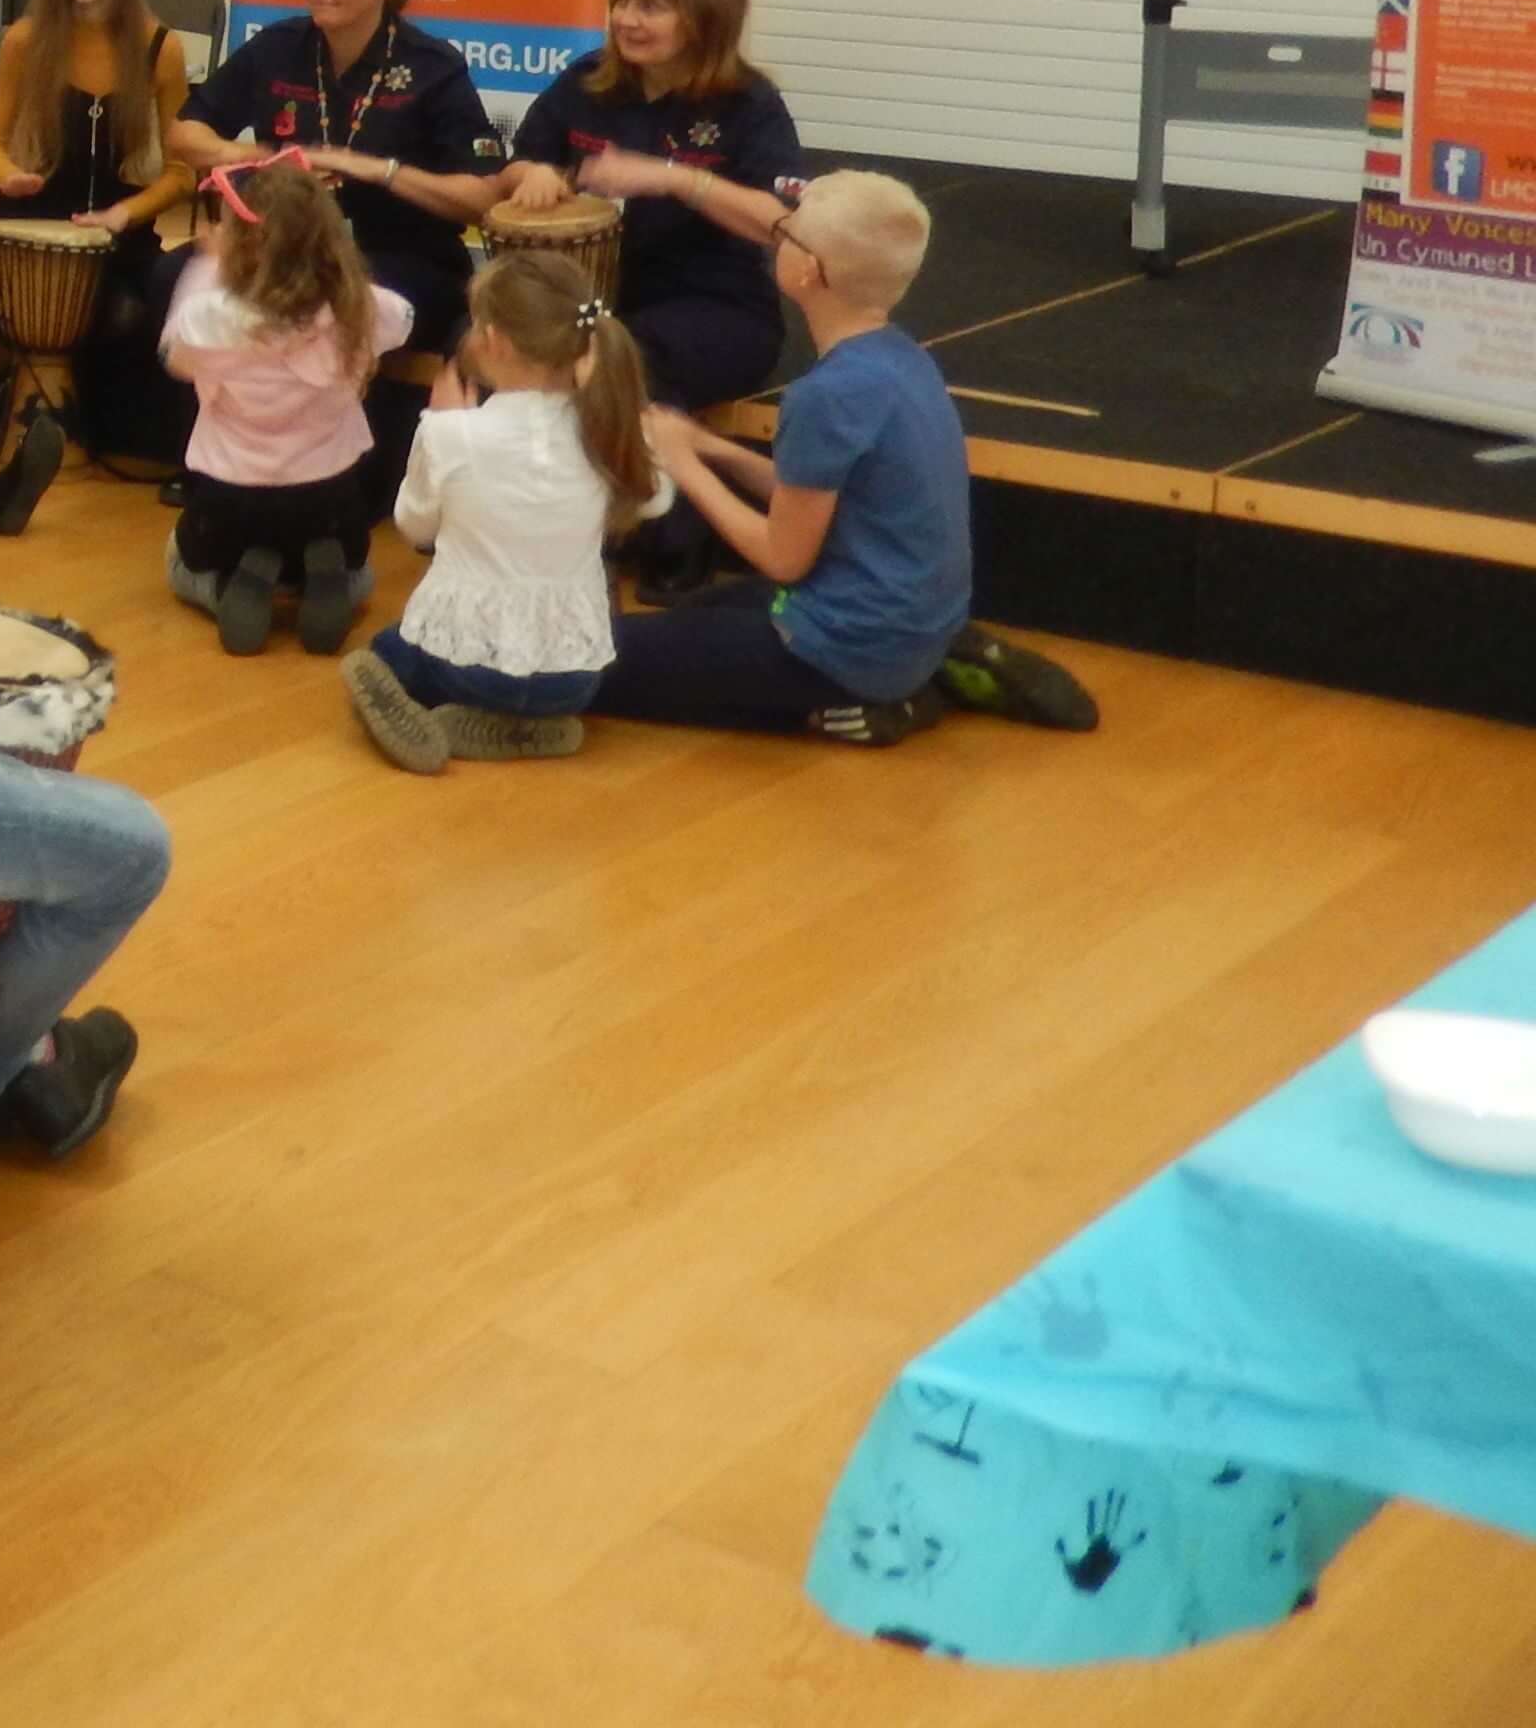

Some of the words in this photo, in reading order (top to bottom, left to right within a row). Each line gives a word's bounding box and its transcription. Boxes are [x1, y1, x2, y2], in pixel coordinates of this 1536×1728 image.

[1366, 202, 1431, 236] Many
[1359, 233, 1386, 257] Un
[1397, 239, 1514, 274] Cymuned
